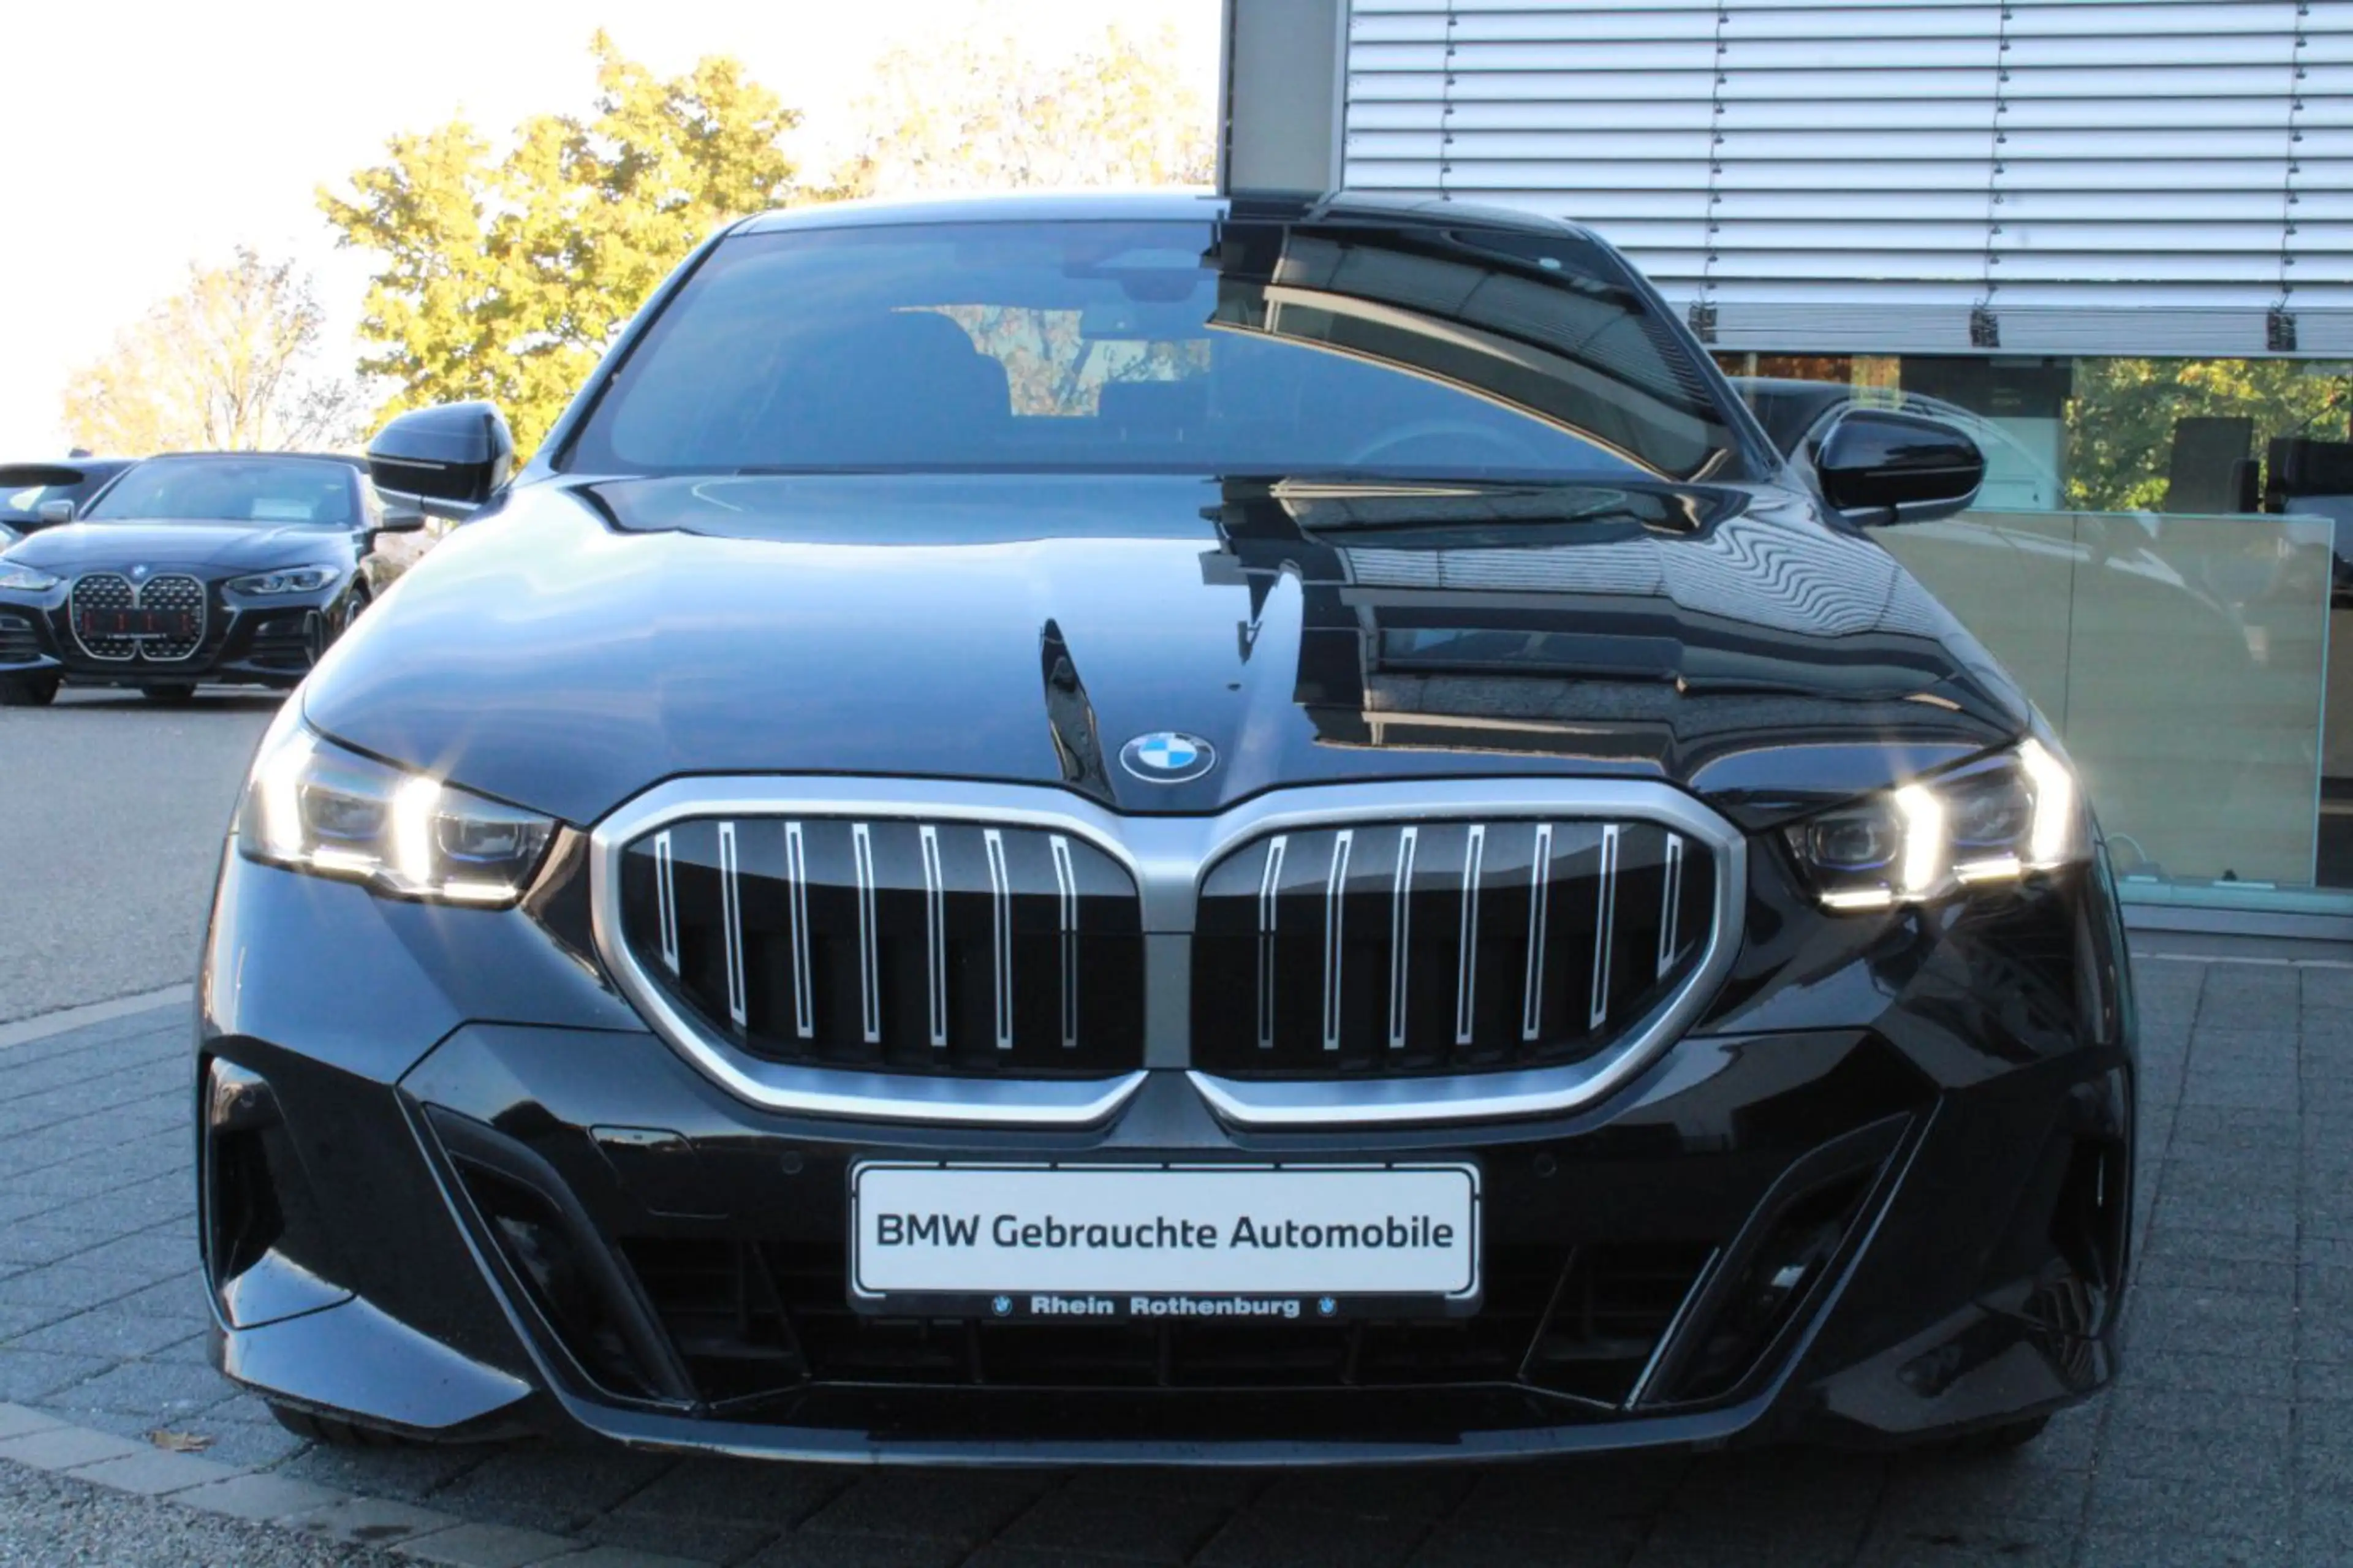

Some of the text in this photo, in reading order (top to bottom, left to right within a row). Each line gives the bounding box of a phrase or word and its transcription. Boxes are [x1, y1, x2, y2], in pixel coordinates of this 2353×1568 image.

[877, 1214, 1453, 1248] BMW Gebrauchte Automobile
[1031, 1295, 1300, 1318] Rhein Rothenburg
